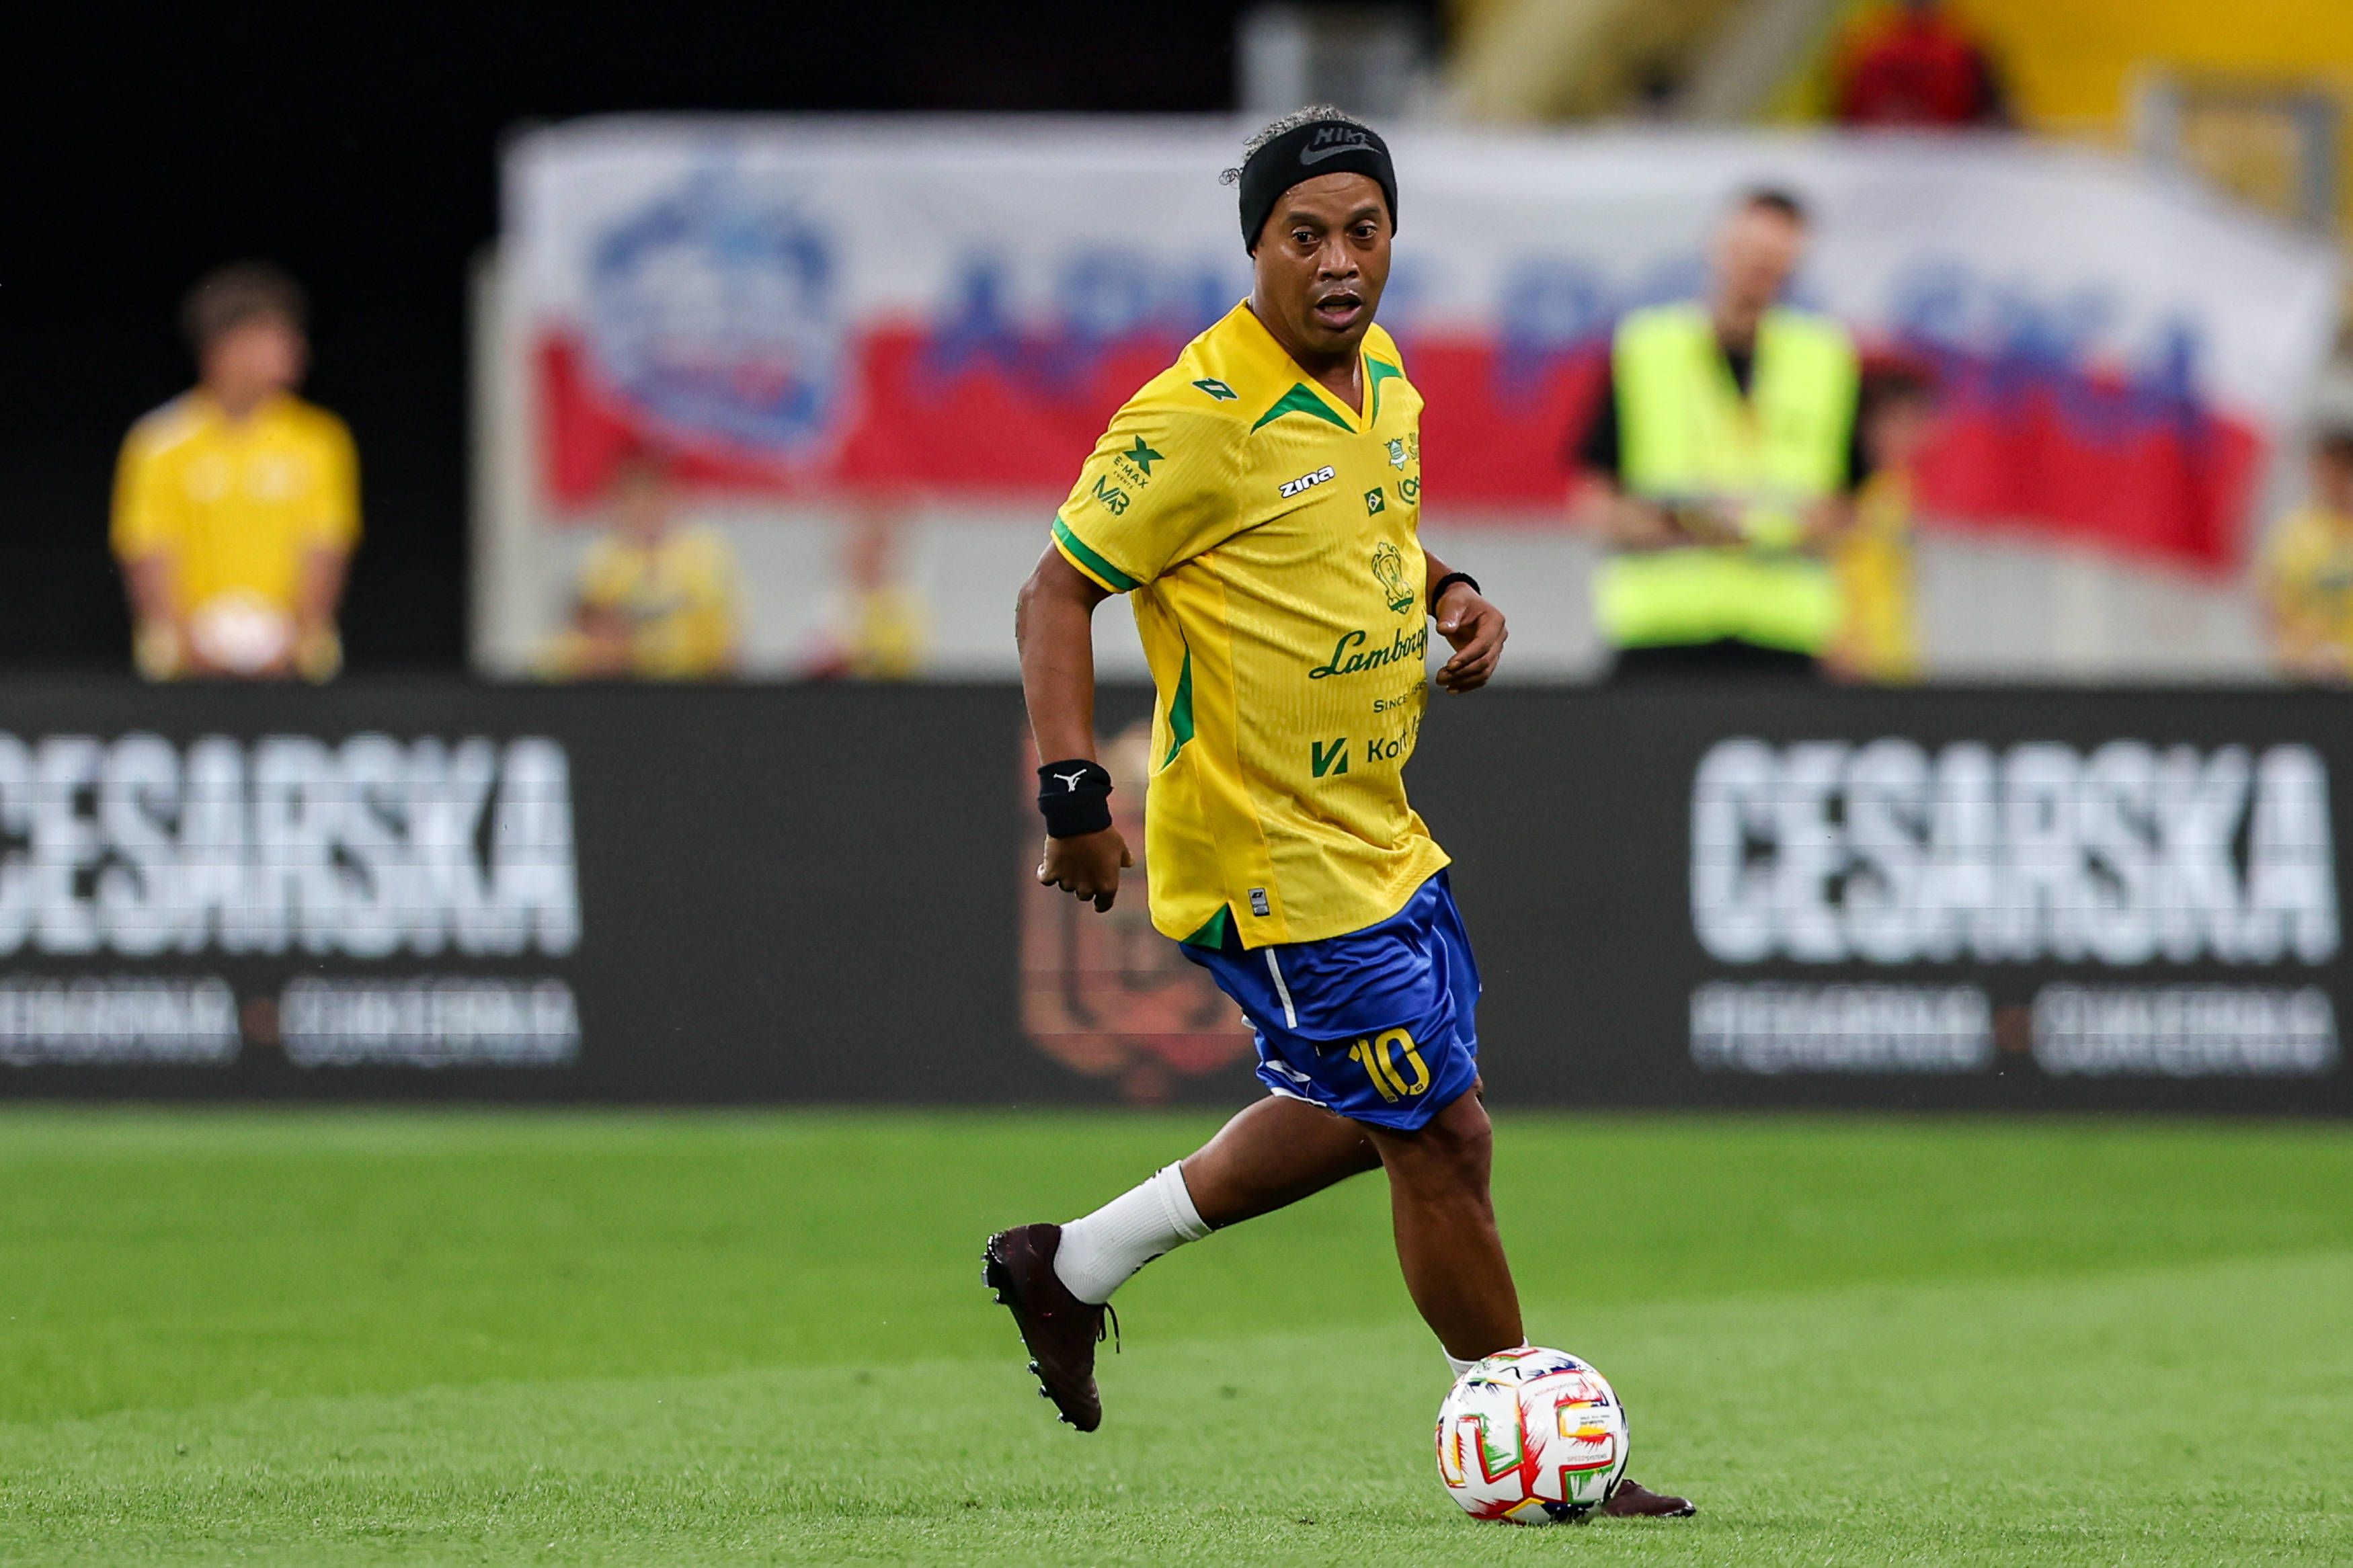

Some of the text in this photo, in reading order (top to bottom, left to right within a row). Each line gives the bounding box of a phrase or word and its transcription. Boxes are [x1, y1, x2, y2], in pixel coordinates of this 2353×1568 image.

[1113, 456, 1149, 489] E-MAX
[1309, 622, 1427, 679] Lamborg
[1691, 738, 2336, 964] CESARSKA
[1348, 1028, 1430, 1103] 10
